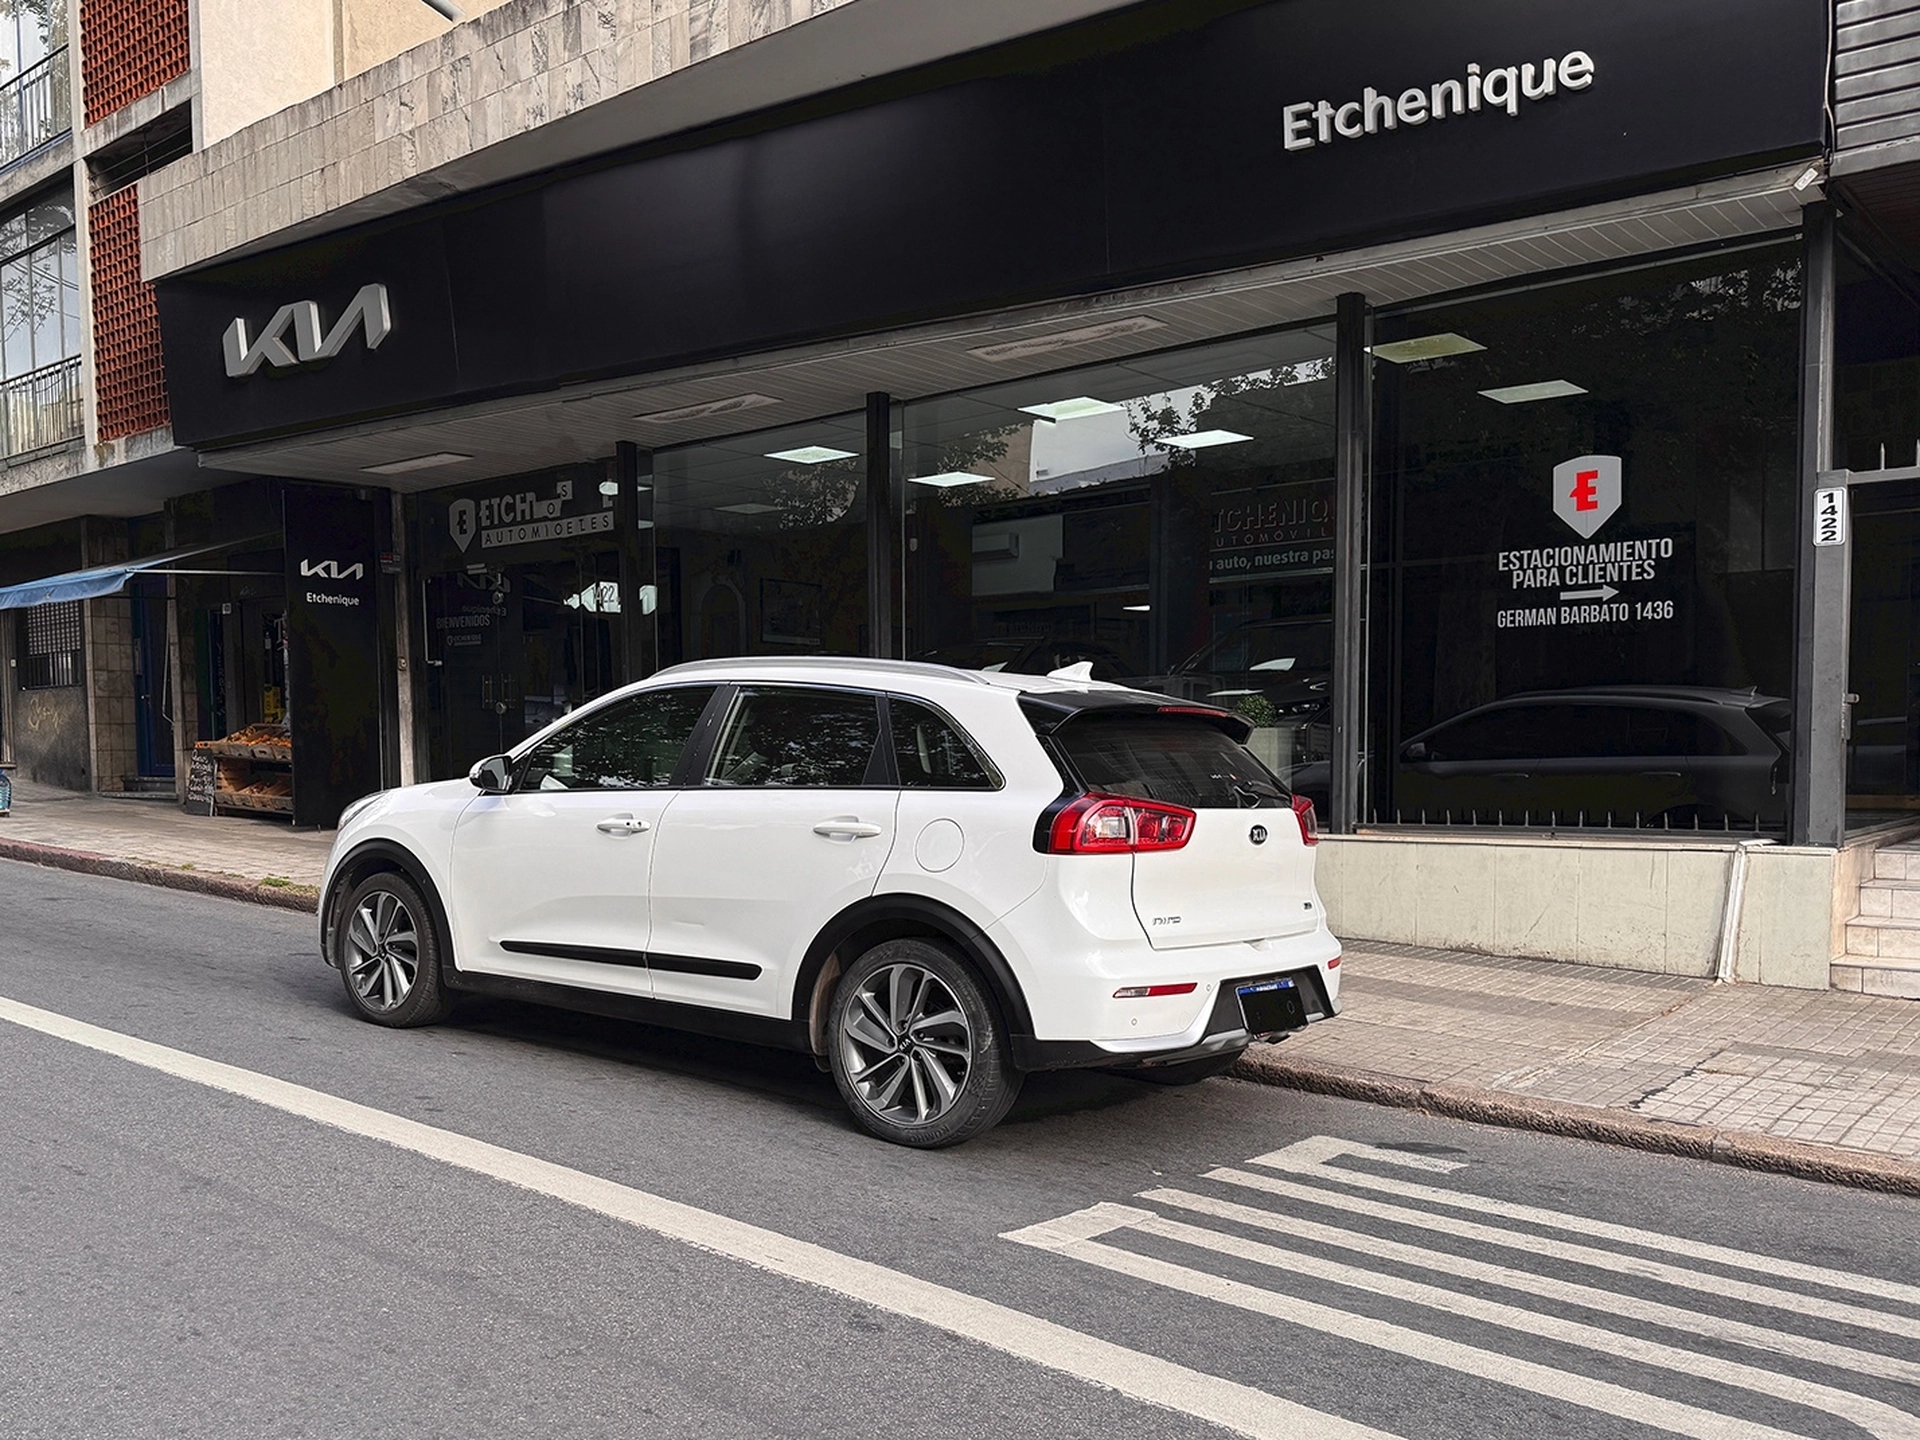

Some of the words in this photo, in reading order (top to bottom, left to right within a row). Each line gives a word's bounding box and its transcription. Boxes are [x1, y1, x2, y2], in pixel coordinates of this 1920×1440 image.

[1283, 50, 1595, 150] Etchenique
[223, 283, 391, 377] KIA
[1821, 492, 1838, 542] 1422
[1216, 555, 1252, 570] auto,
[1254, 550, 1309, 567] nuestra
[1498, 538, 1673, 571] ESTACIONAMIENTO
[300, 559, 364, 580] KIA
[1512, 567, 1561, 589] PARA
[1565, 560, 1656, 586] CLIENTES
[306, 592, 360, 607] Etchenique
[1497, 607, 1557, 628] GERMAN
[1561, 603, 1629, 625] BARBATO
[1635, 600, 1674, 621] 1436
